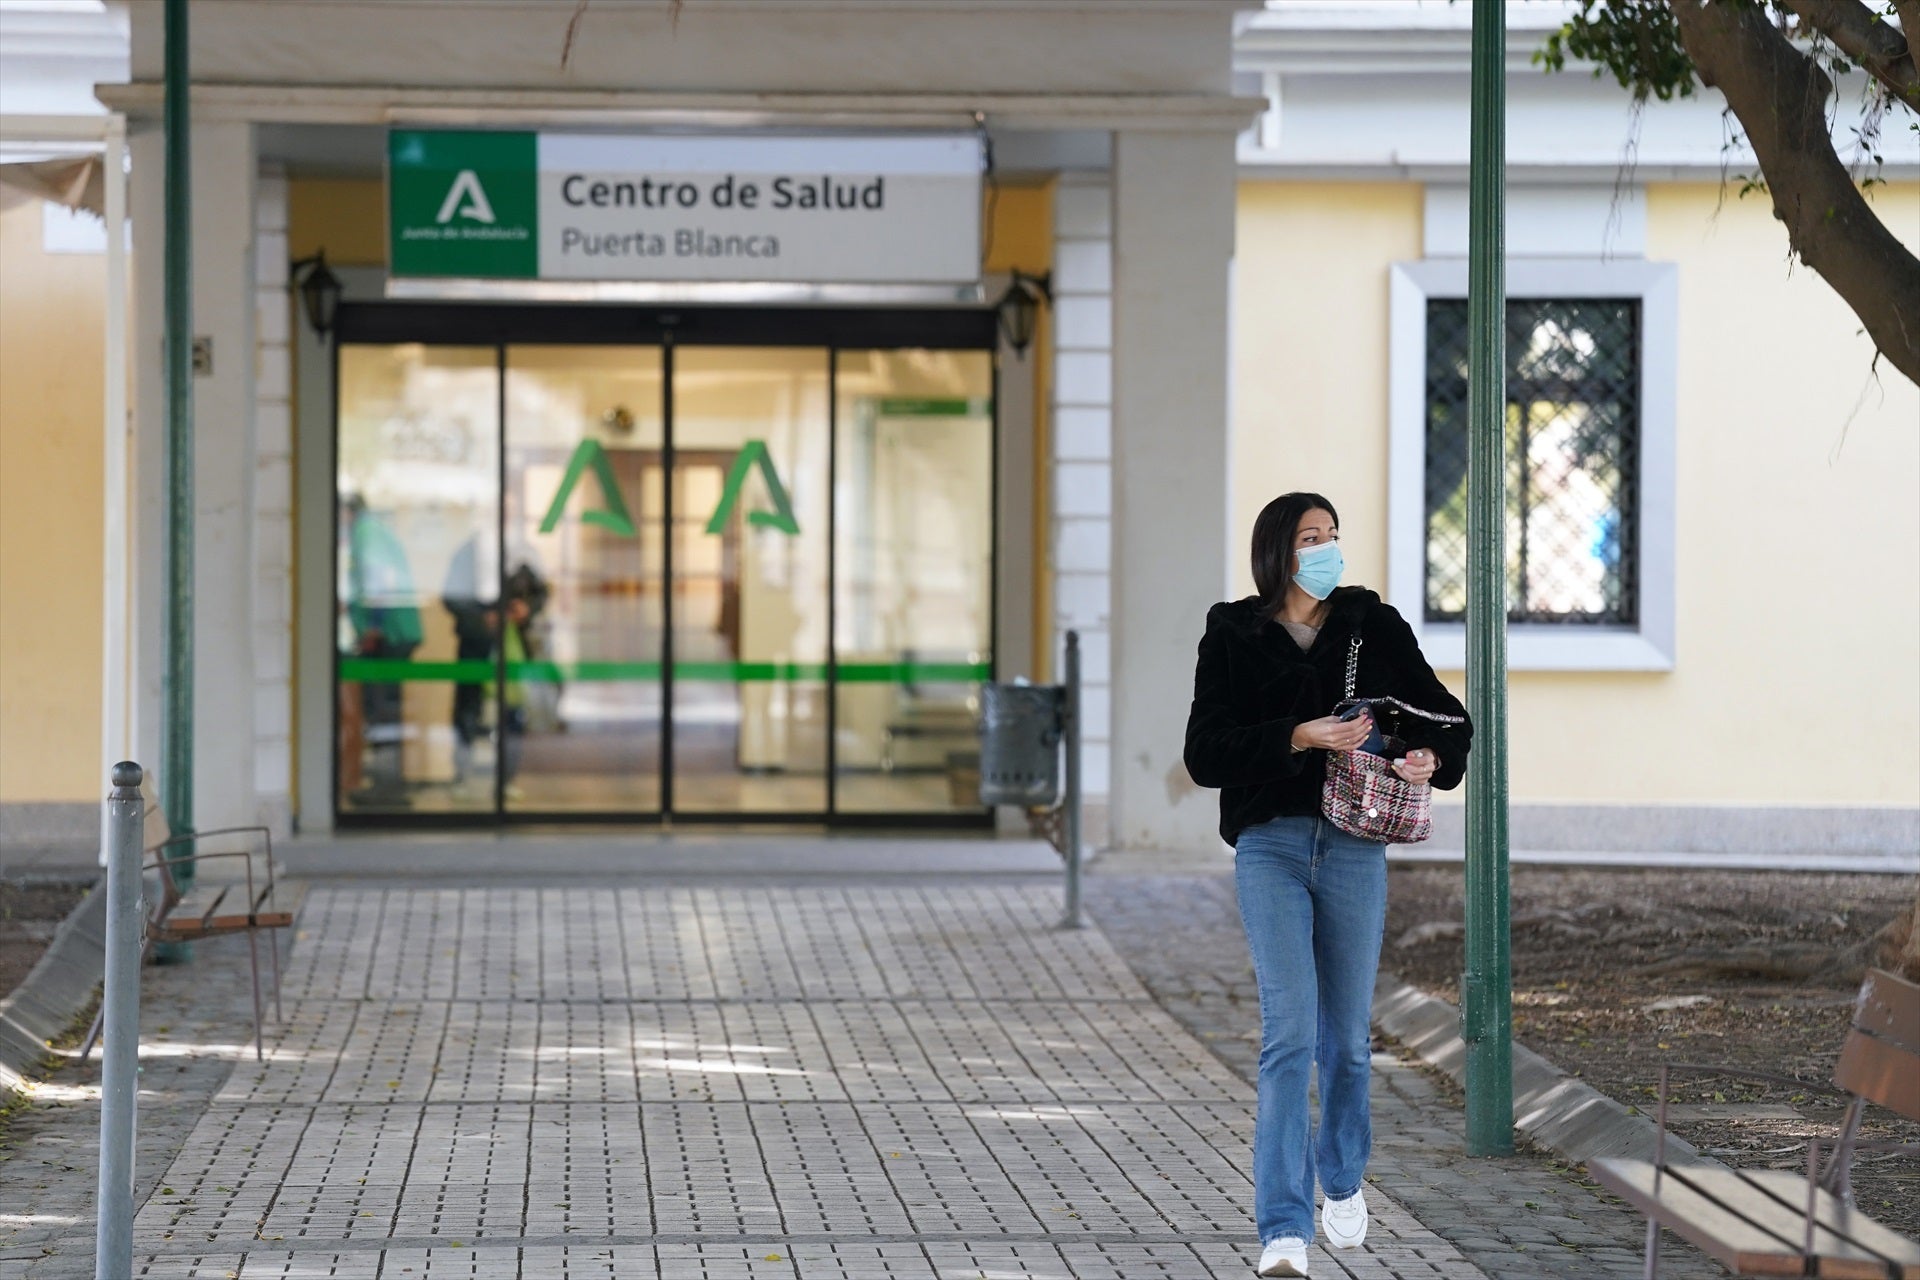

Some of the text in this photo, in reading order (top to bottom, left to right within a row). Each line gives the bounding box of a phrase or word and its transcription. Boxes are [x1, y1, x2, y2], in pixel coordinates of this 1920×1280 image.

[562, 174, 885, 210] Centro de Salud
[562, 227, 779, 258] Puerta Blanca
